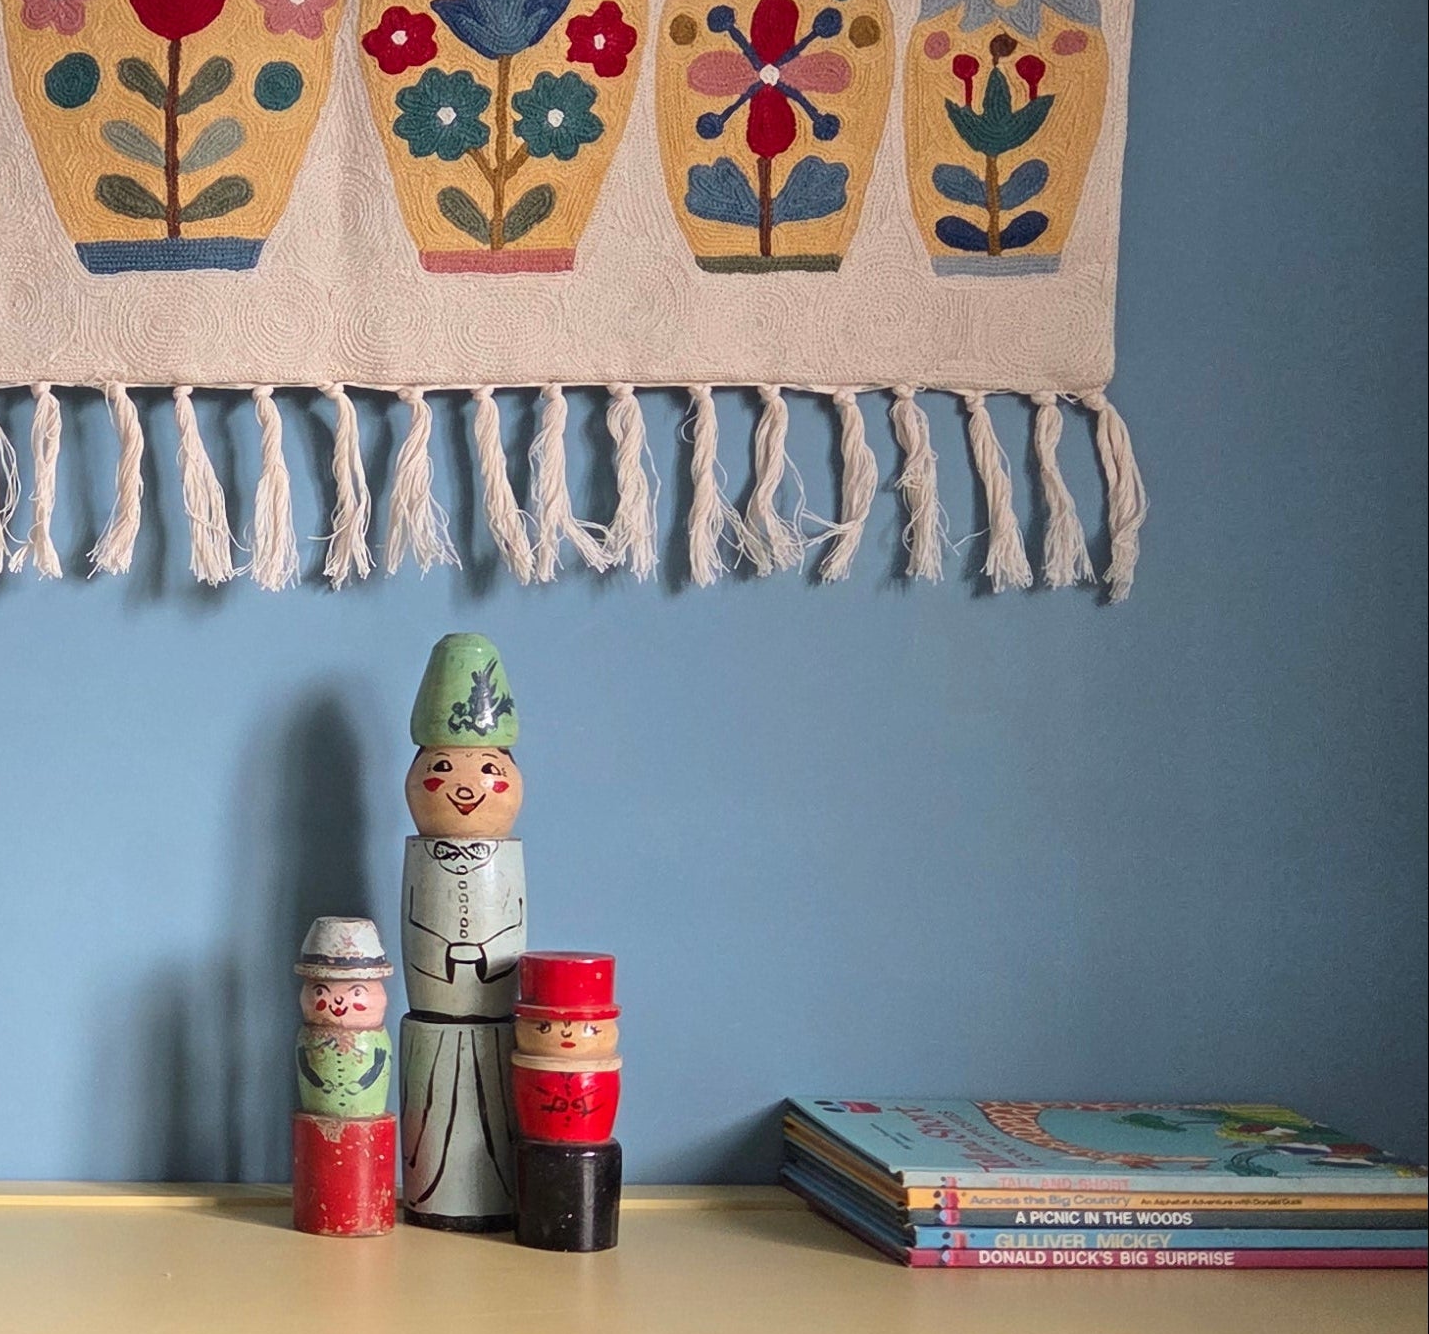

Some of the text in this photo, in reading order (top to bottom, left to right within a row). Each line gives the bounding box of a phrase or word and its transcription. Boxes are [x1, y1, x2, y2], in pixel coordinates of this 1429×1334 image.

[1016, 1211, 1193, 1225] A PICNIC IN THE WOODS
[995, 1233, 1171, 1248] GULLIVER MICKEY
[979, 1251, 1235, 1265] DONALD DUCK'S BIG SURPRISE
